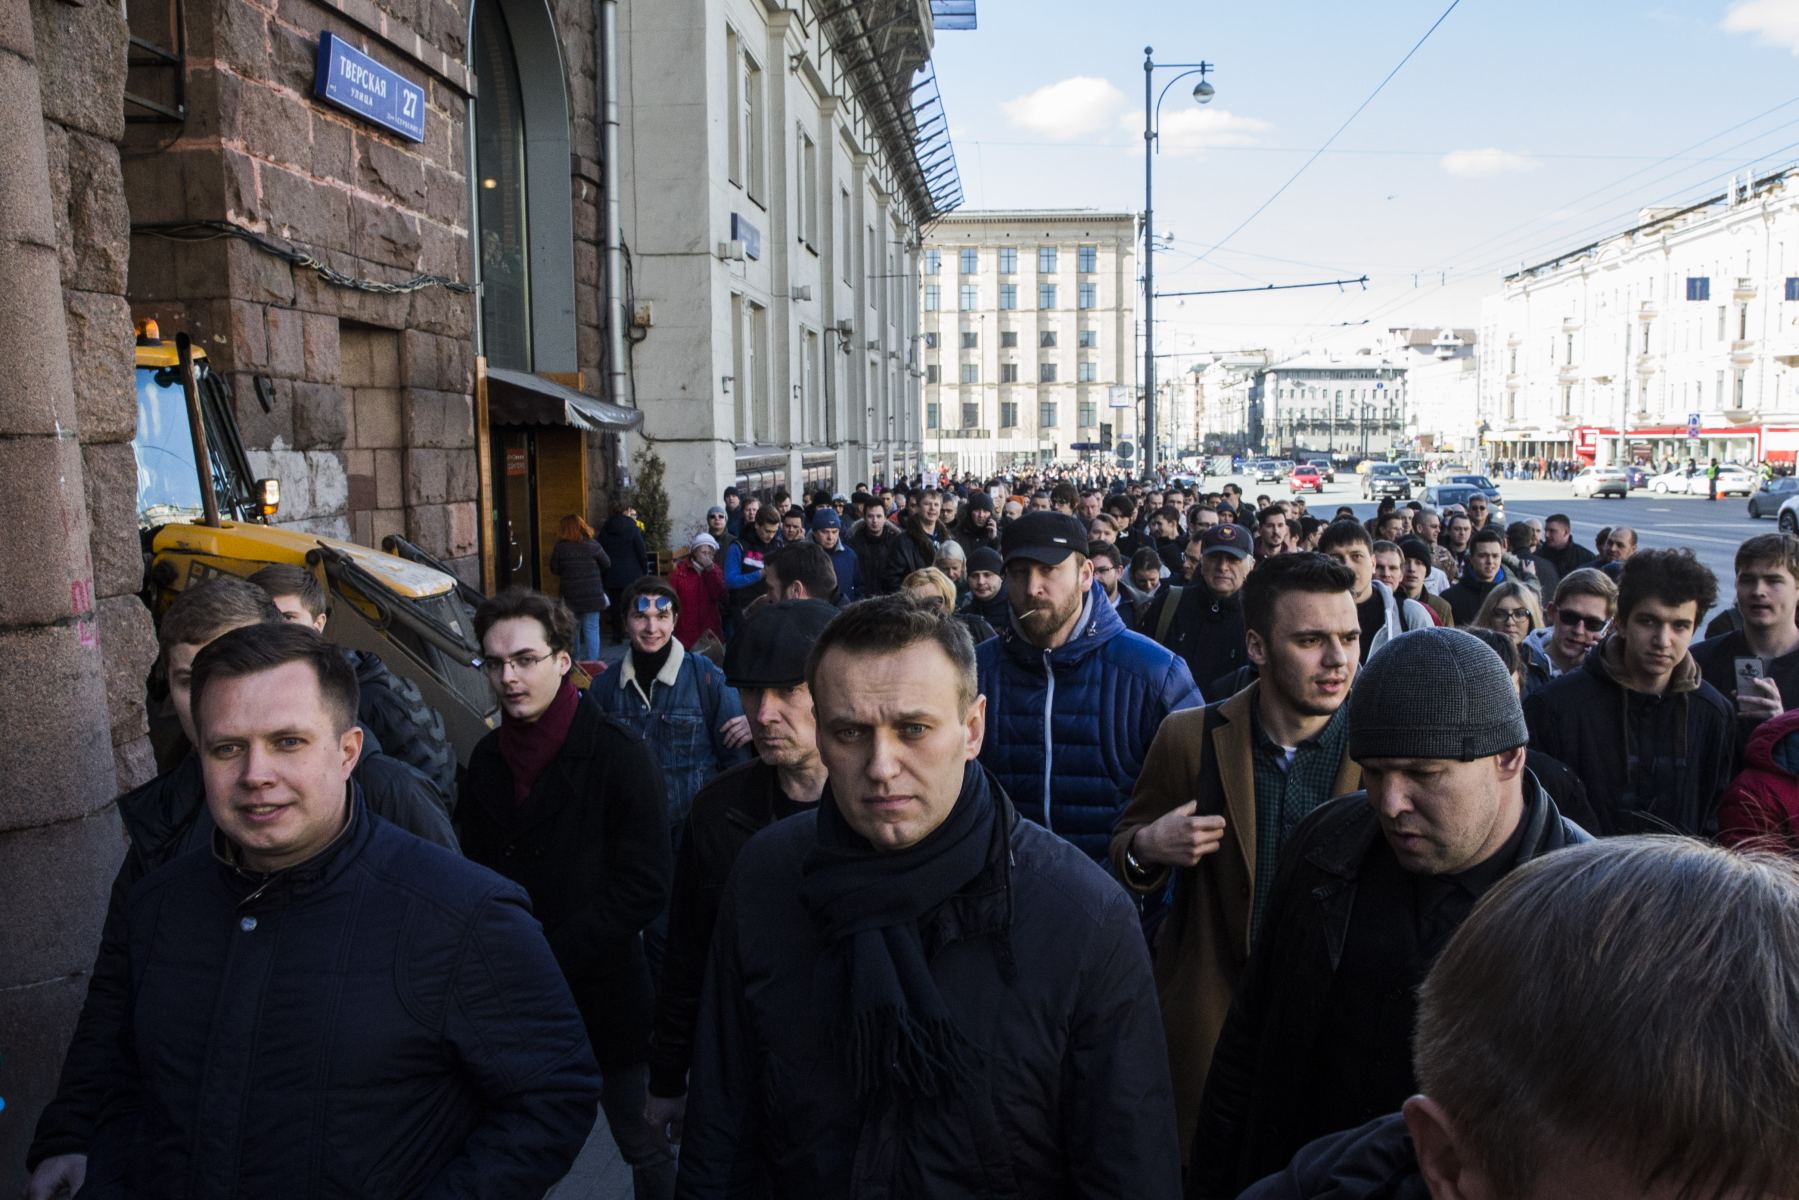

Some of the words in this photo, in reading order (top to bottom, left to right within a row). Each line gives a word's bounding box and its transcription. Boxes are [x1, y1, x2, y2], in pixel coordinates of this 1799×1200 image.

[340, 55, 387, 99] ТВЕРСКАЯ
[351, 87, 373, 107] УЛИЦА
[403, 89, 418, 119] 27
